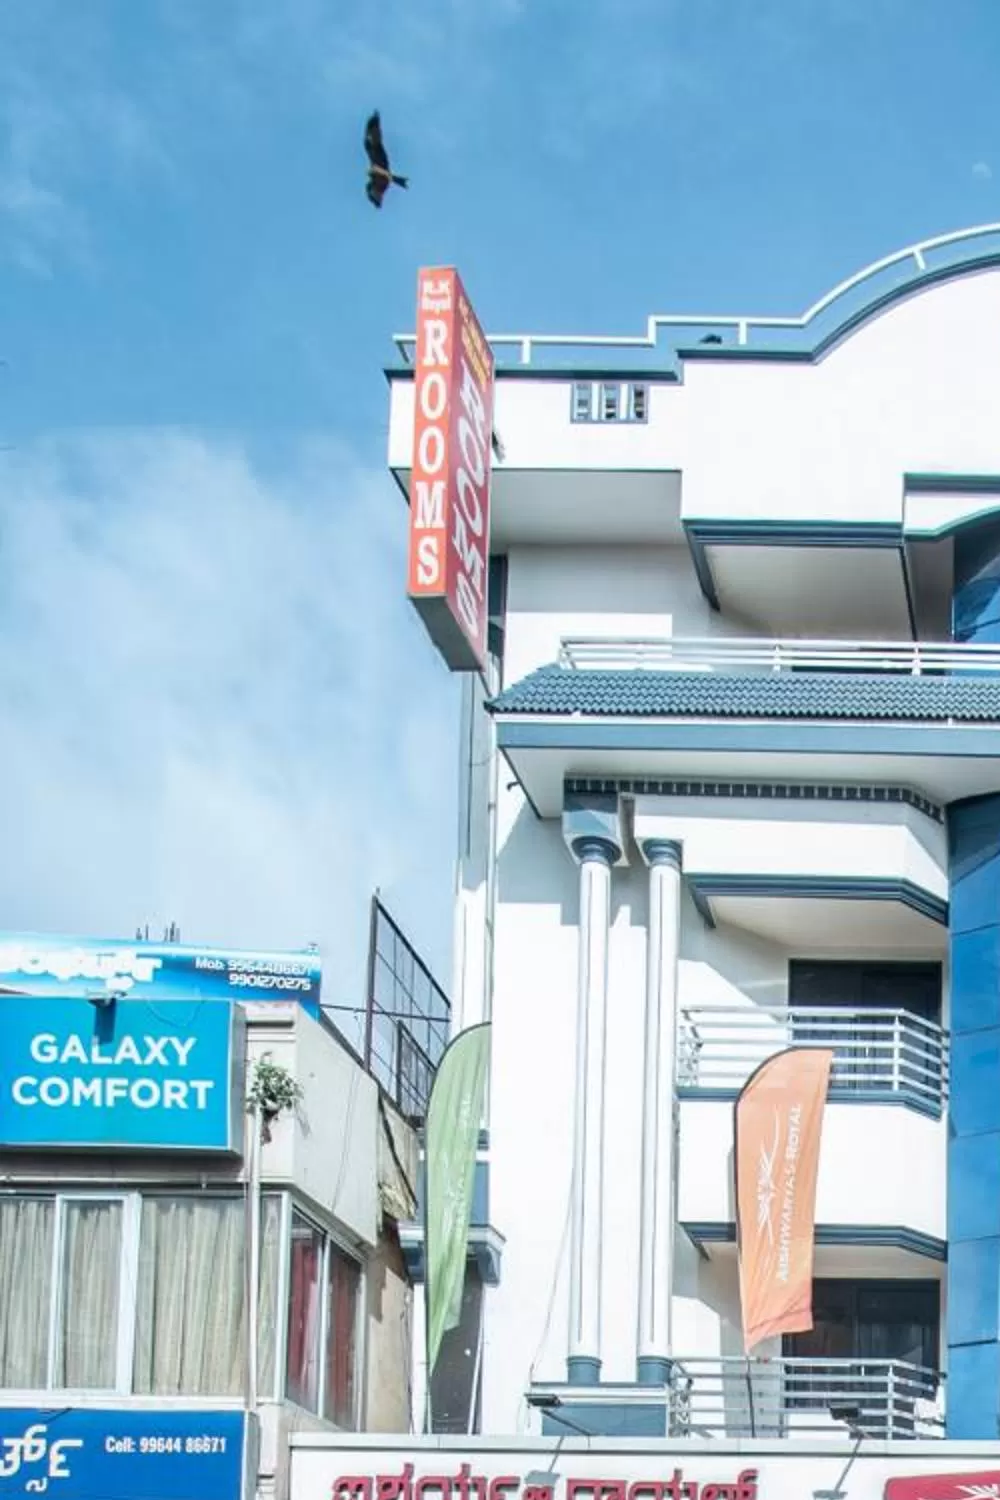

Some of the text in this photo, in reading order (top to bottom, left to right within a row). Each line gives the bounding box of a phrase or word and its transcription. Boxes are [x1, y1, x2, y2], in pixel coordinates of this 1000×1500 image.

[415, 319, 449, 586] ROOMS
[453, 358, 486, 639] ROOMS
[30, 1034, 196, 1065] GALAXY
[12, 1077, 214, 1109] COMFORT
[105, 1436, 137, 1453] Cell:
